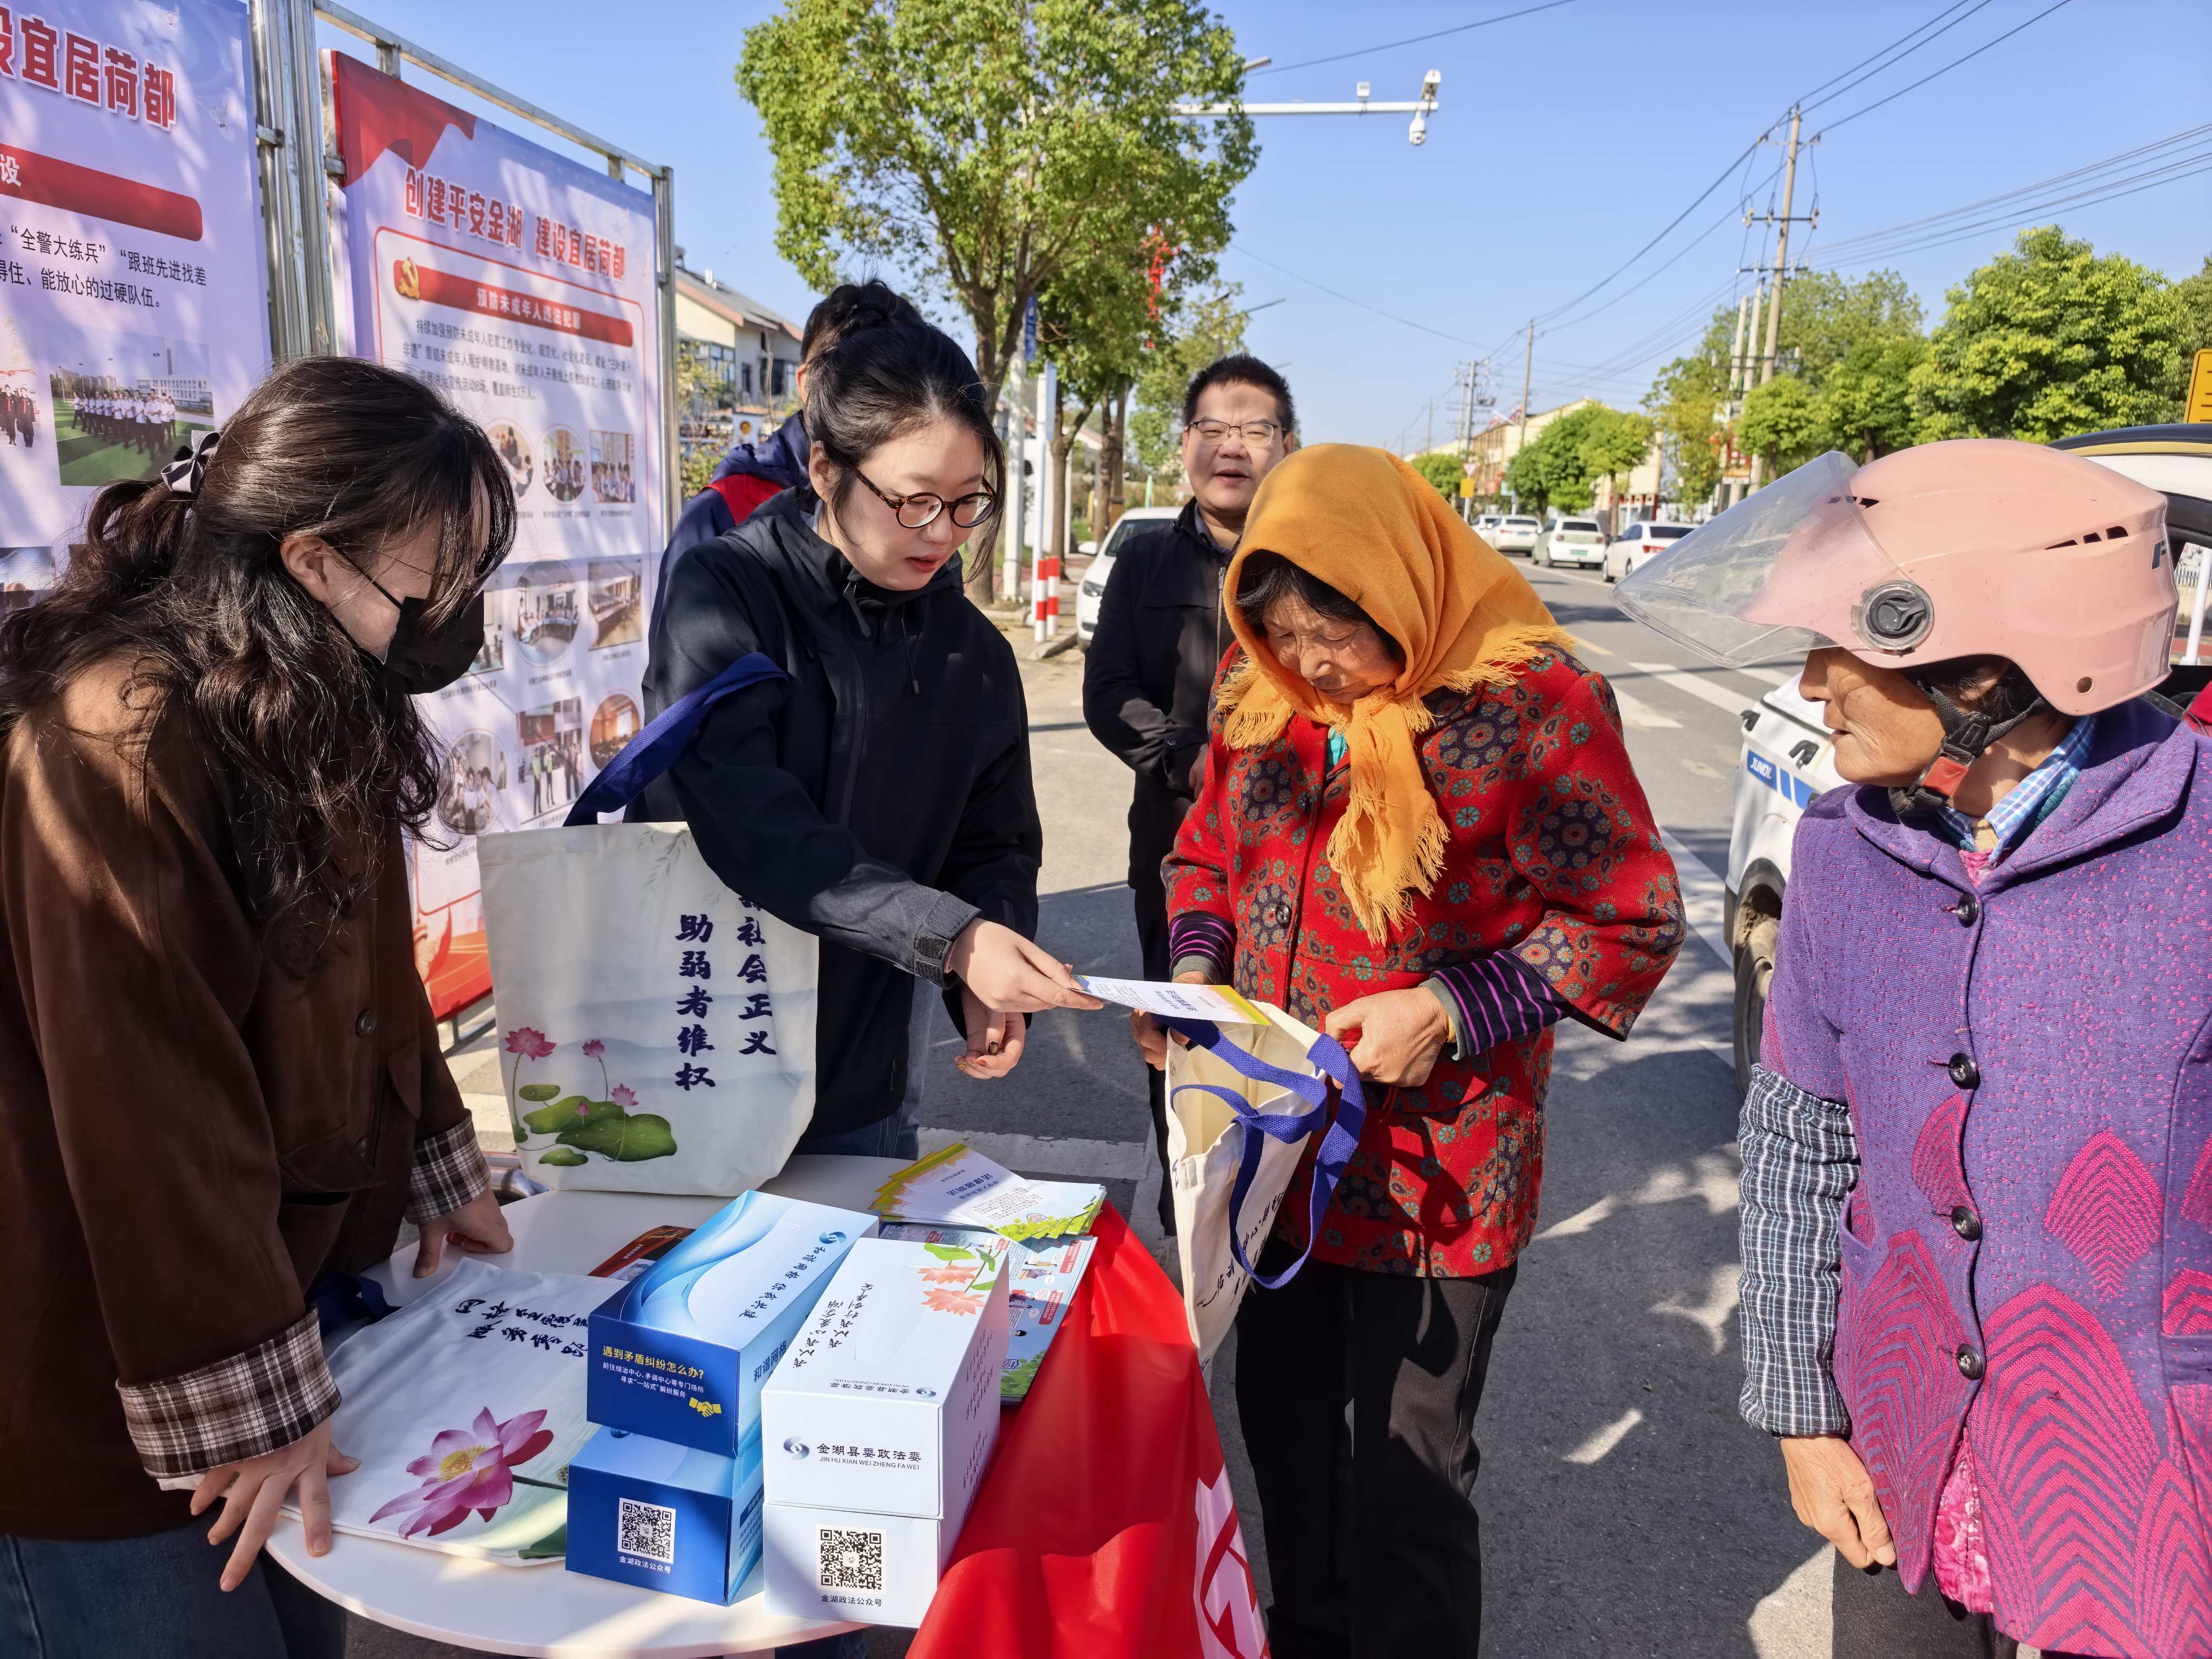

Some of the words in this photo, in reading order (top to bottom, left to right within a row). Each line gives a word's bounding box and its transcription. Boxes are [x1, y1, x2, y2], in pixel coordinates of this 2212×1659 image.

[405, 167, 523, 249] 创建平安金湖
[536, 216, 625, 281] 建设宜居荷都
[477, 287, 581, 329] 预防未成年人违法犯罪
[675, 914, 716, 1091] 助弱者维权
[946, 1173, 994, 1196] 法律援助法
[792, 1300, 844, 1368] 我以我心爱金湖
[603, 1345, 704, 1379] 遇到矛盾纠纷怎么办?
[603, 1362, 704, 1393] 前往综治中心、矛调中心等专门场所
[754, 1340, 787, 1383] 和谐网格
[817, 1443, 922, 1462] 金湖县委政法委
[619, 1555, 671, 1574] 金湖政法公众号
[821, 1594, 882, 1607] 金湖政法公众号
